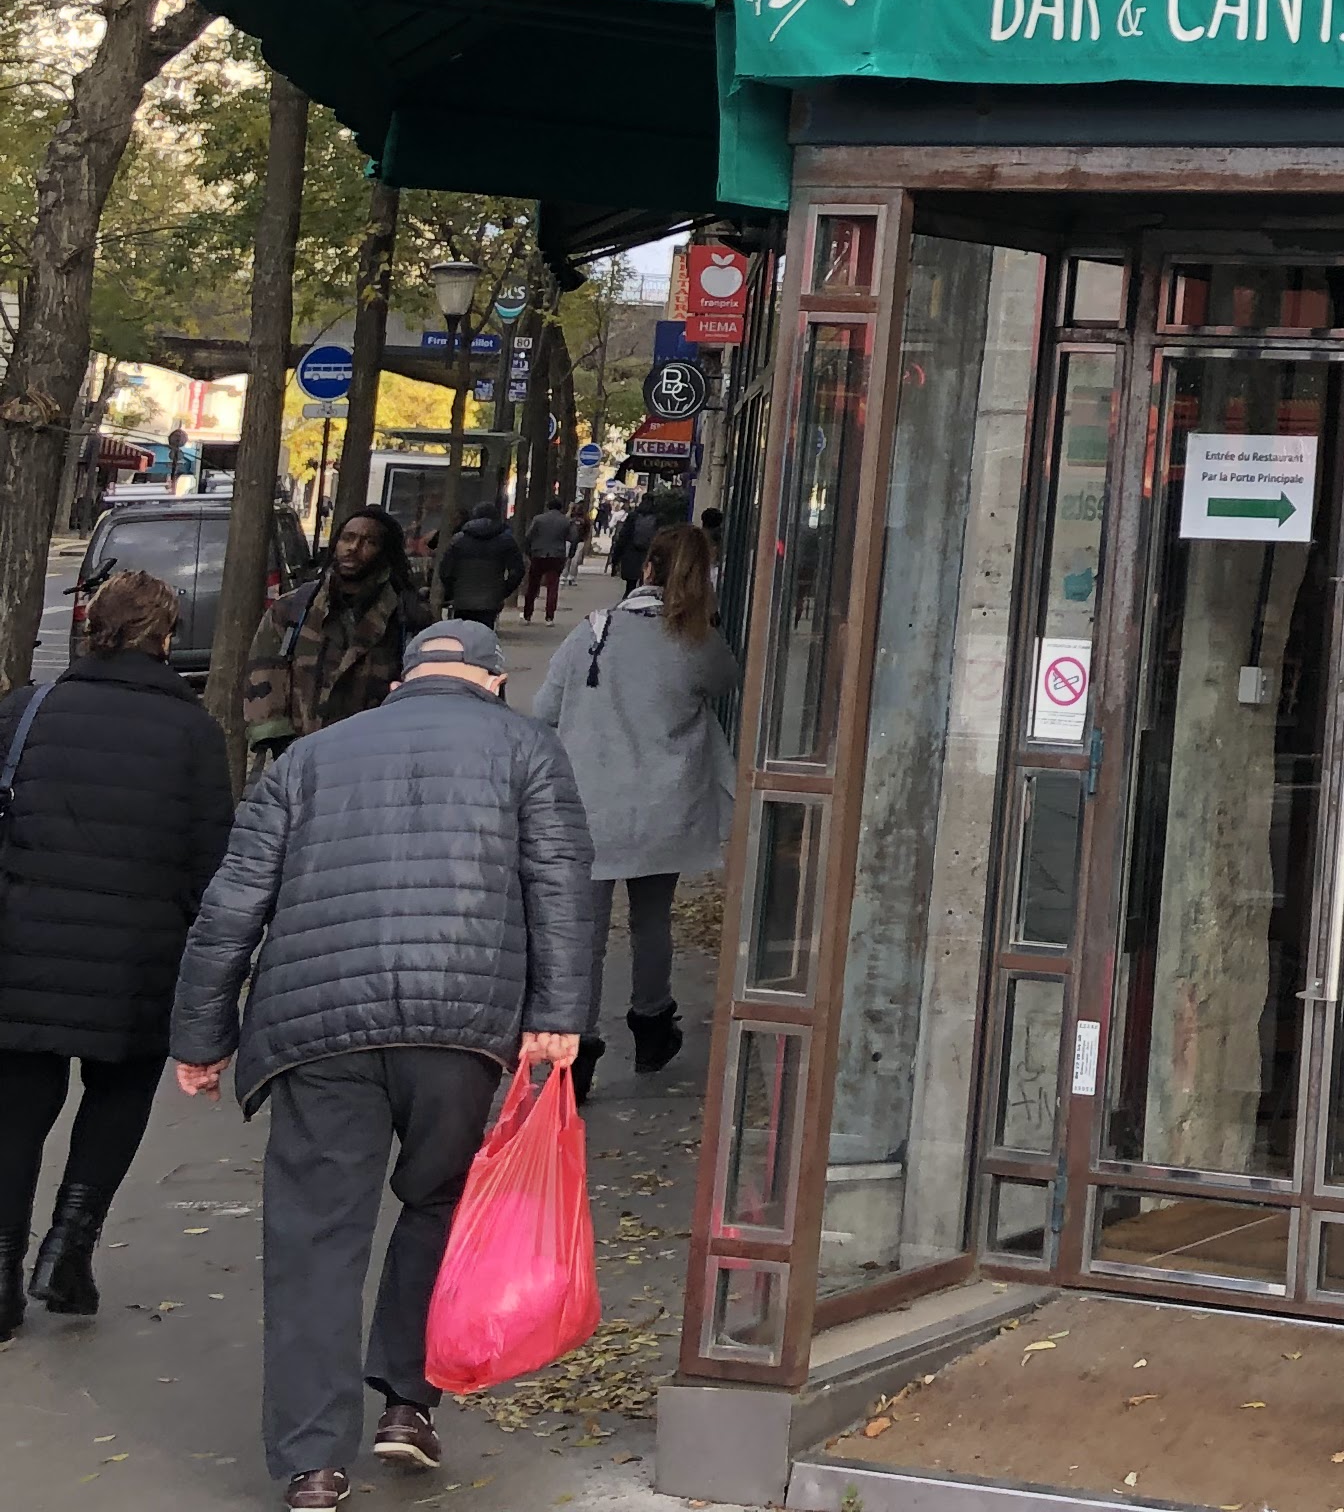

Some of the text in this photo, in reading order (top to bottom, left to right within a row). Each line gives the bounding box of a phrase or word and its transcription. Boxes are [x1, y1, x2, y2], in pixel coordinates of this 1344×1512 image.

[700, 298, 739, 308] franprix
[699, 321, 738, 332] HEMA
[516, 338, 531, 348] 80
[635, 440, 687, 455] KEBAB
[1205, 451, 1304, 463] Entrée du Restaurant
[1201, 471, 1304, 485] Par la Porte Principale
